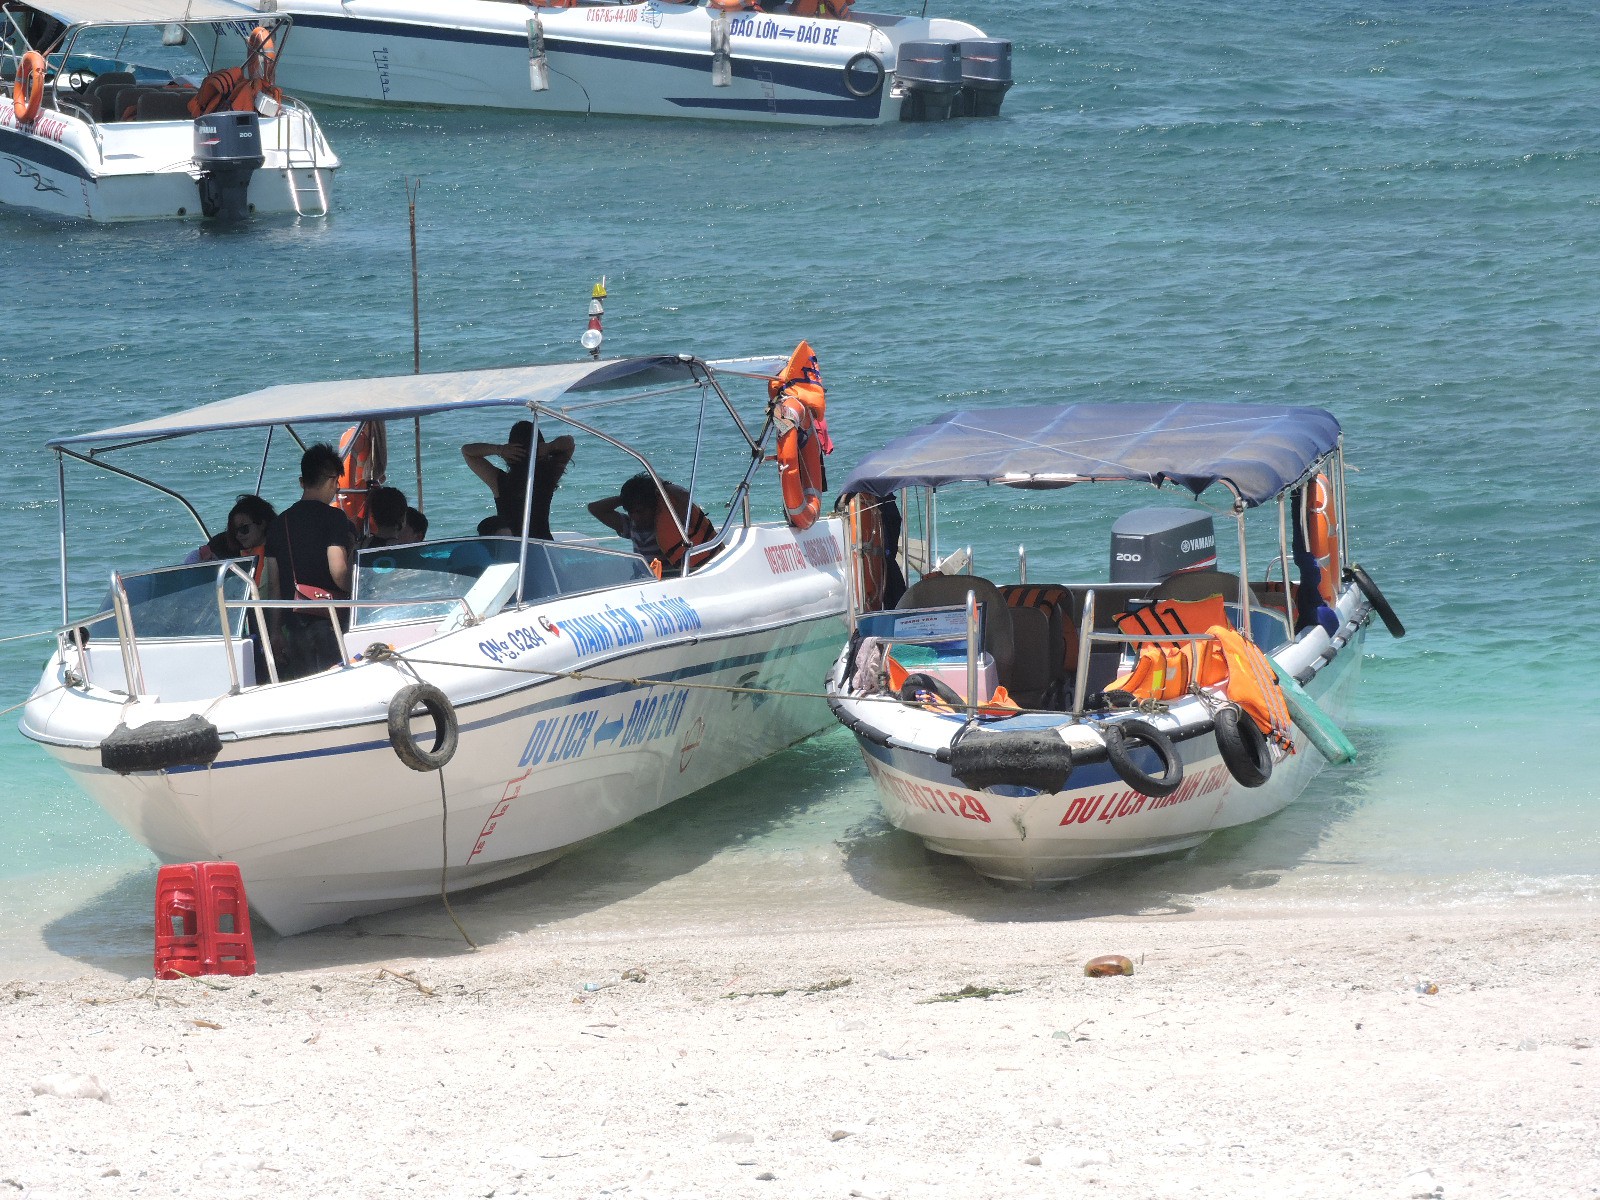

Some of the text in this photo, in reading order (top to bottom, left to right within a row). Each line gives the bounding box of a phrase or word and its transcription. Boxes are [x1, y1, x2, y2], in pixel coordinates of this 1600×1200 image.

[755, 18, 780, 40] LỚN
[822, 25, 841, 46] BÉ
[1190, 534, 1215, 551] YAMAHA
[1116, 553, 1142, 562] 200
[517, 716, 561, 768] DU
[1059, 794, 1106, 827] DU
